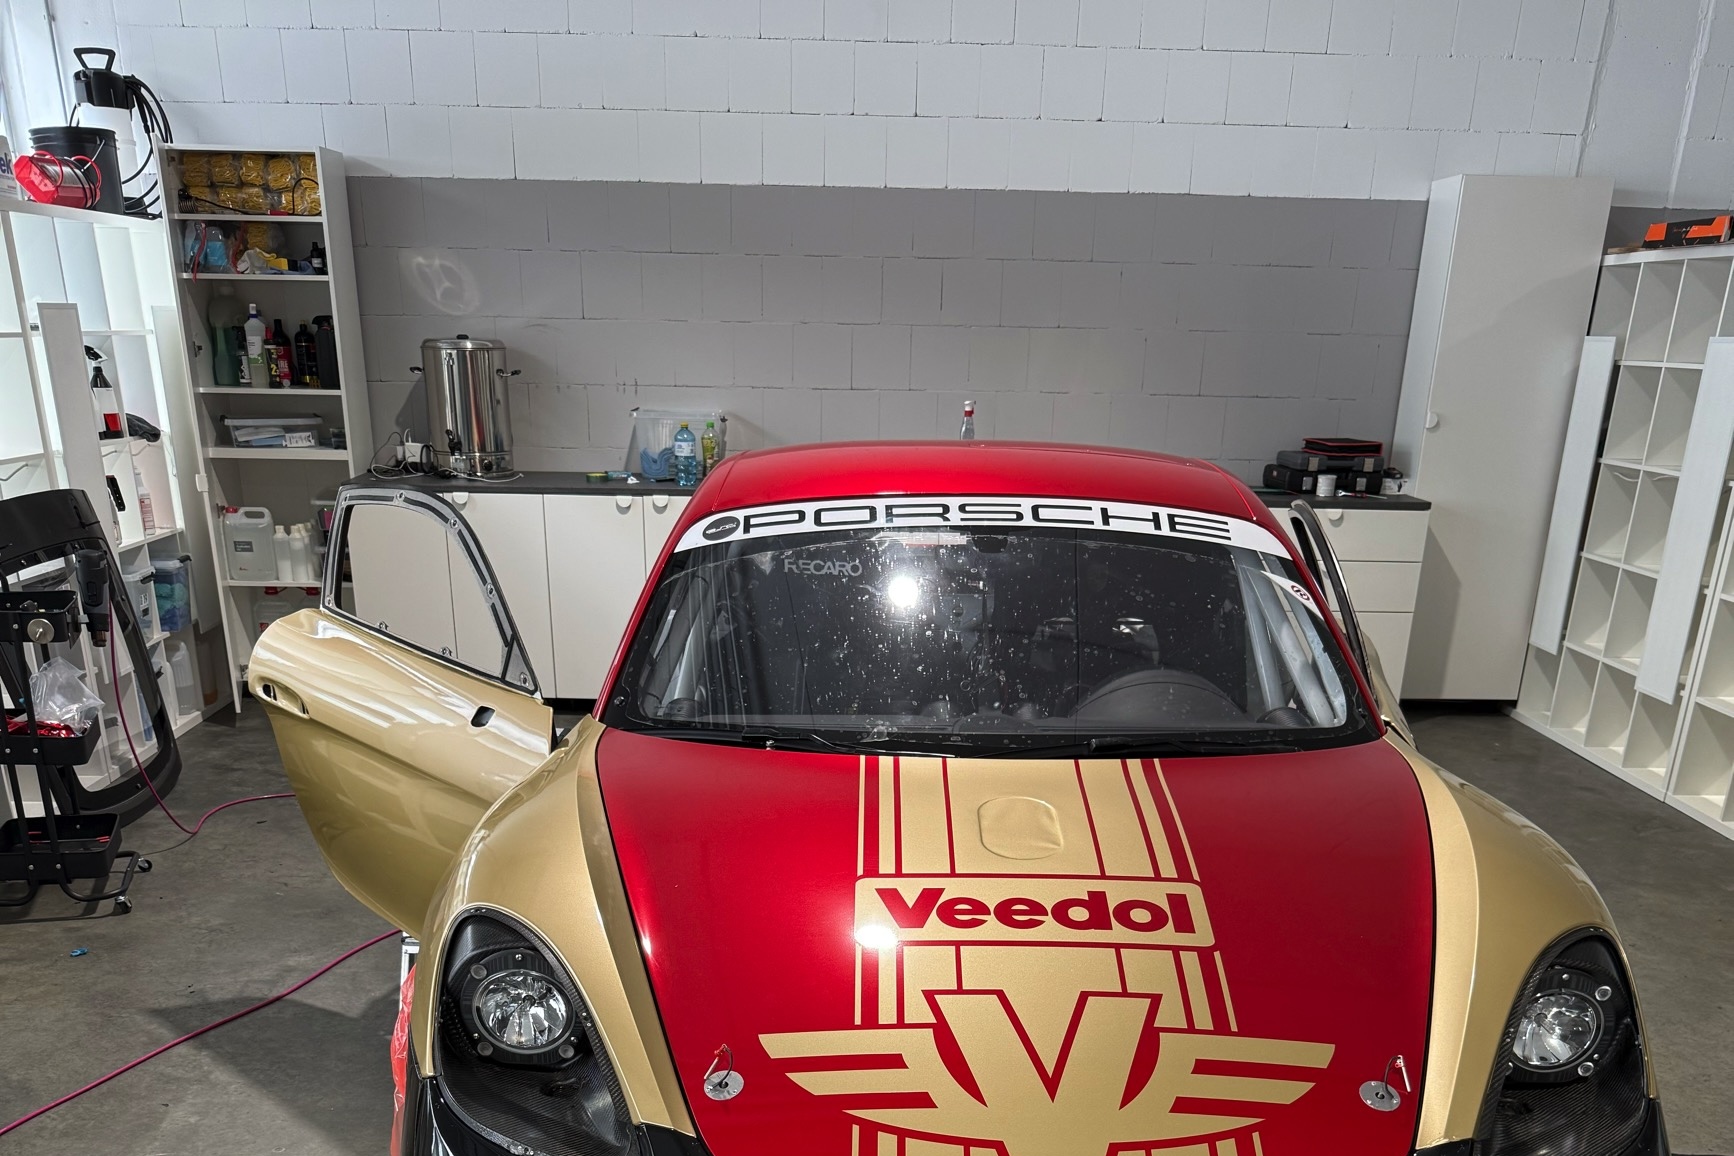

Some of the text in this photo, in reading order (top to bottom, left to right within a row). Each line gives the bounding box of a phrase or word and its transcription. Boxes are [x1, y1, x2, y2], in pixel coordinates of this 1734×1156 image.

[743, 503, 1232, 541] PORSCHE
[783, 558, 863, 577] RECARO
[875, 888, 1197, 934] Veedol
